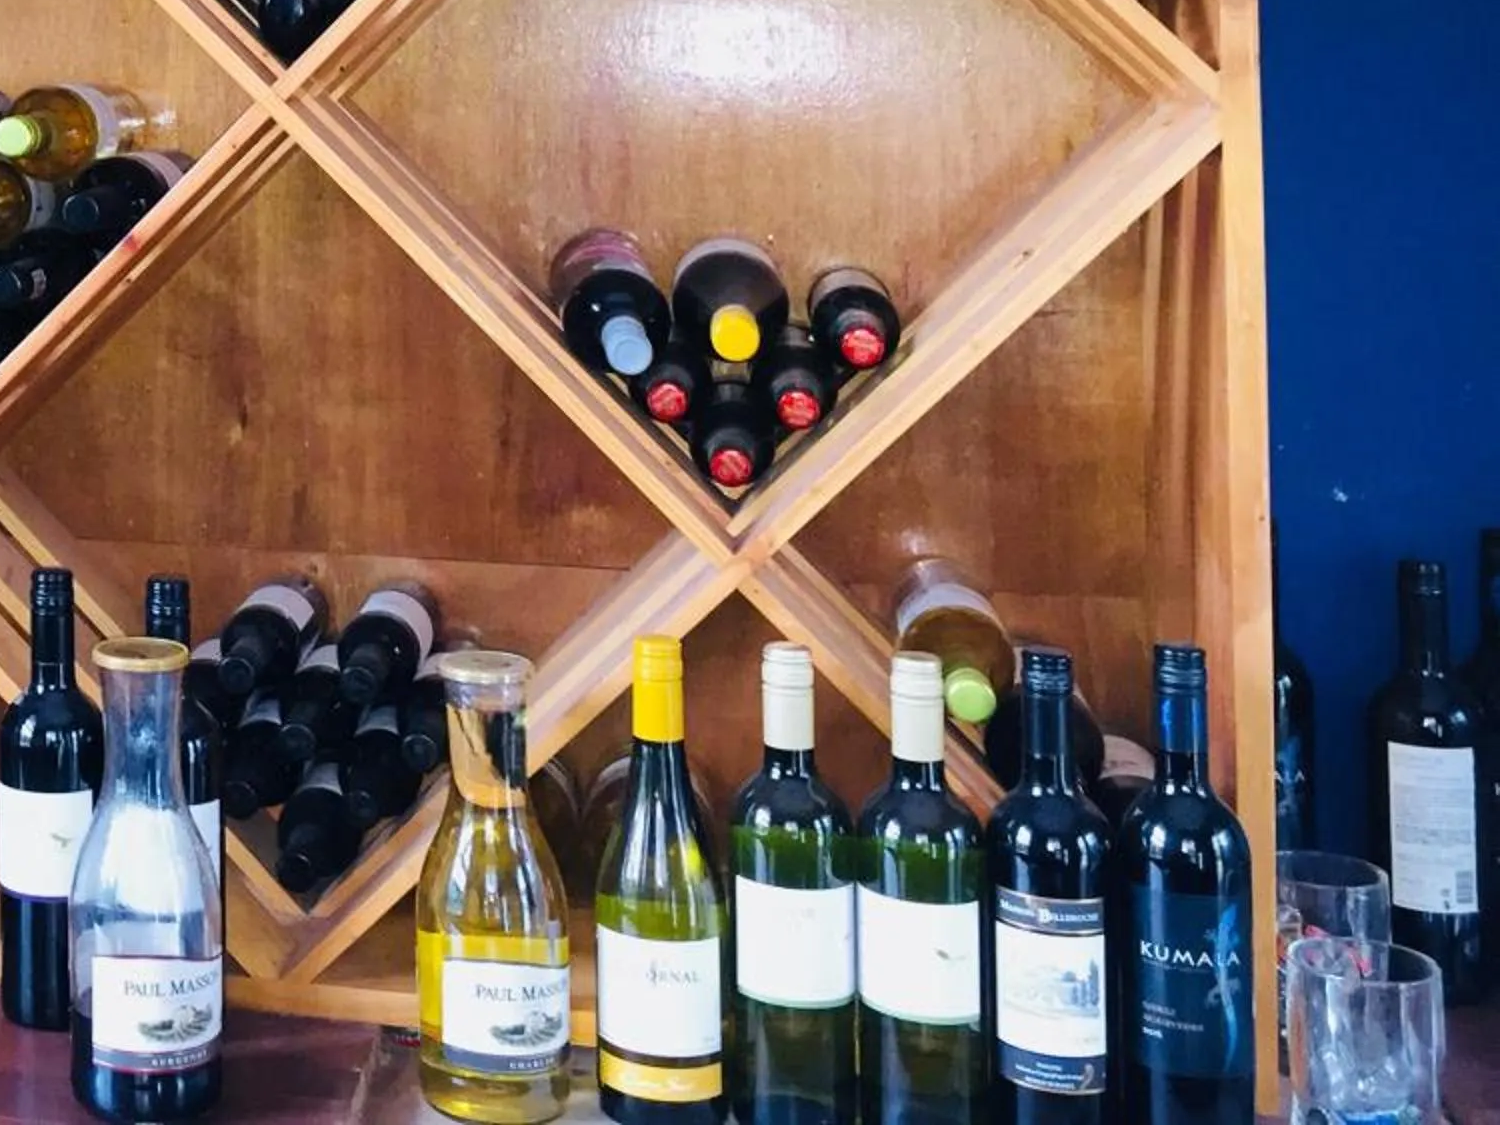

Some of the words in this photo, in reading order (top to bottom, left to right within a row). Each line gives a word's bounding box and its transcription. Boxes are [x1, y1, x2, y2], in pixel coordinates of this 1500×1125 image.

[1141, 940, 1241, 968] KUMALA
[124, 979, 166, 998] PAUL
[169, 971, 218, 996] MASS
[474, 982, 517, 1003] PAUL
[521, 977, 566, 1002] MASS
